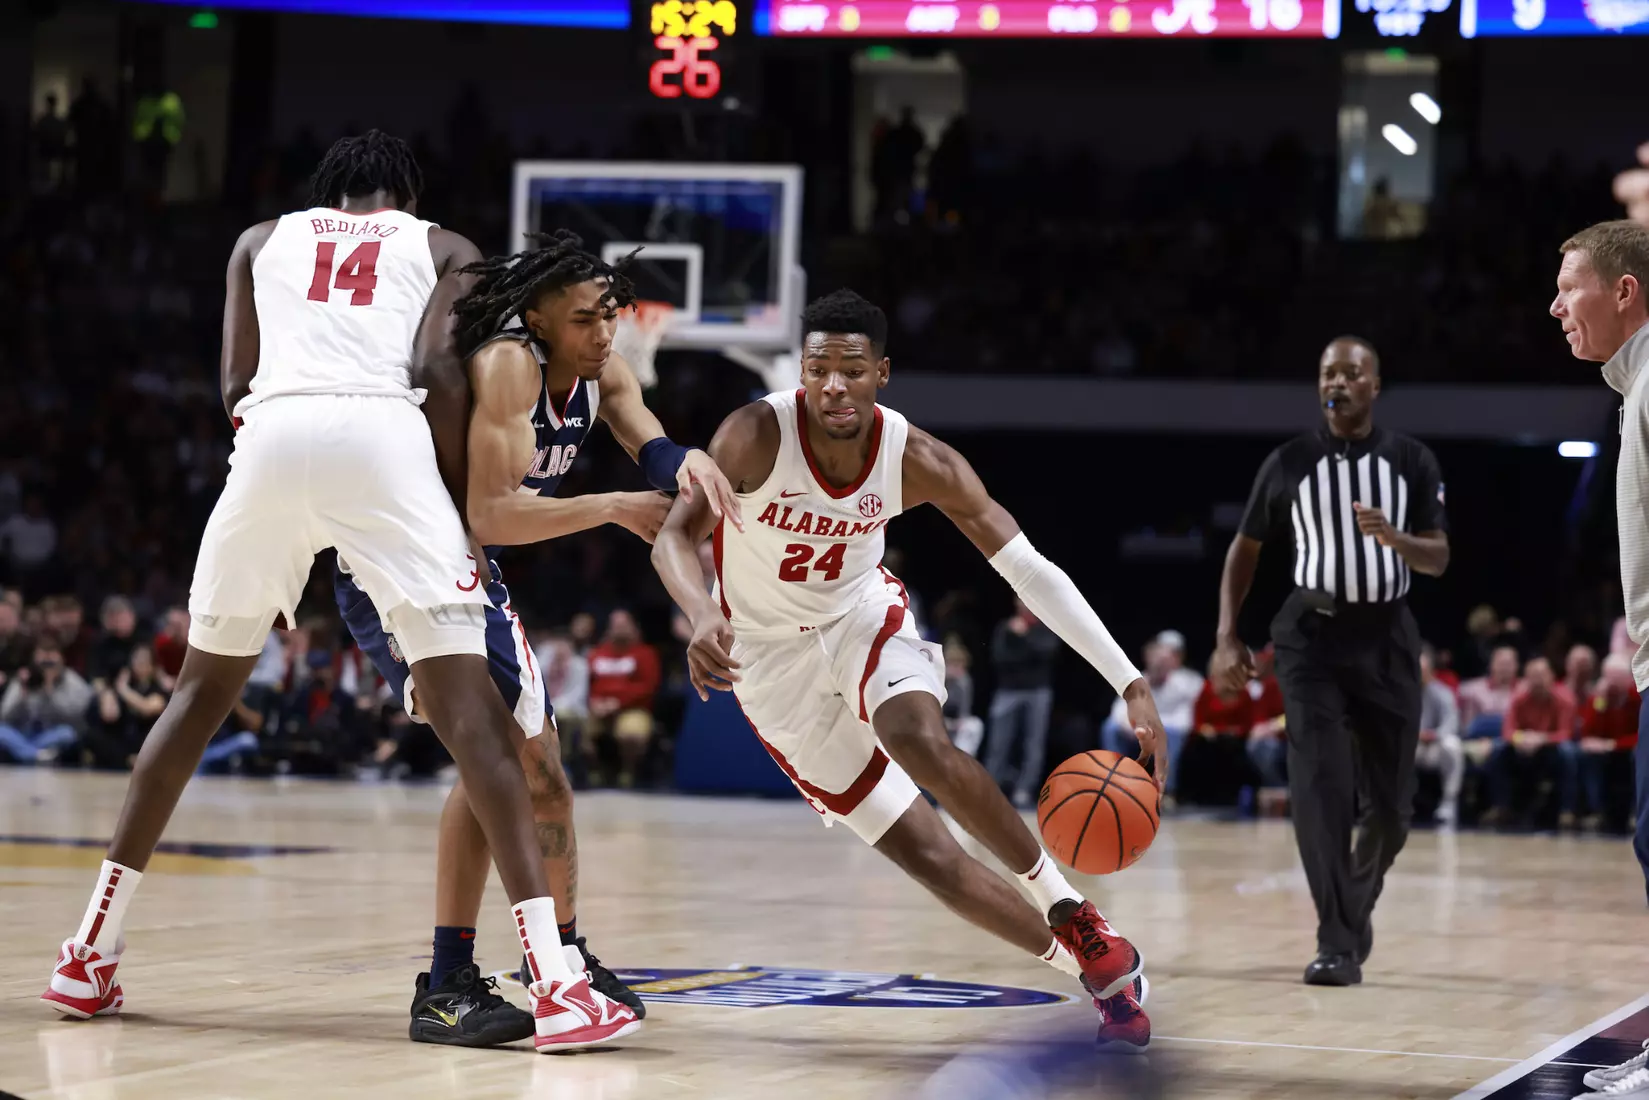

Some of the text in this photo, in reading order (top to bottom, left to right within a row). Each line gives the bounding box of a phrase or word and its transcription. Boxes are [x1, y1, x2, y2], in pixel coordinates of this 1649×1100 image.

[649, 36, 721, 98] 26
[310, 218, 399, 238] BEDIAKO
[307, 241, 381, 306] 14
[859, 494, 882, 517] SEC
[778, 543, 848, 582] 24
